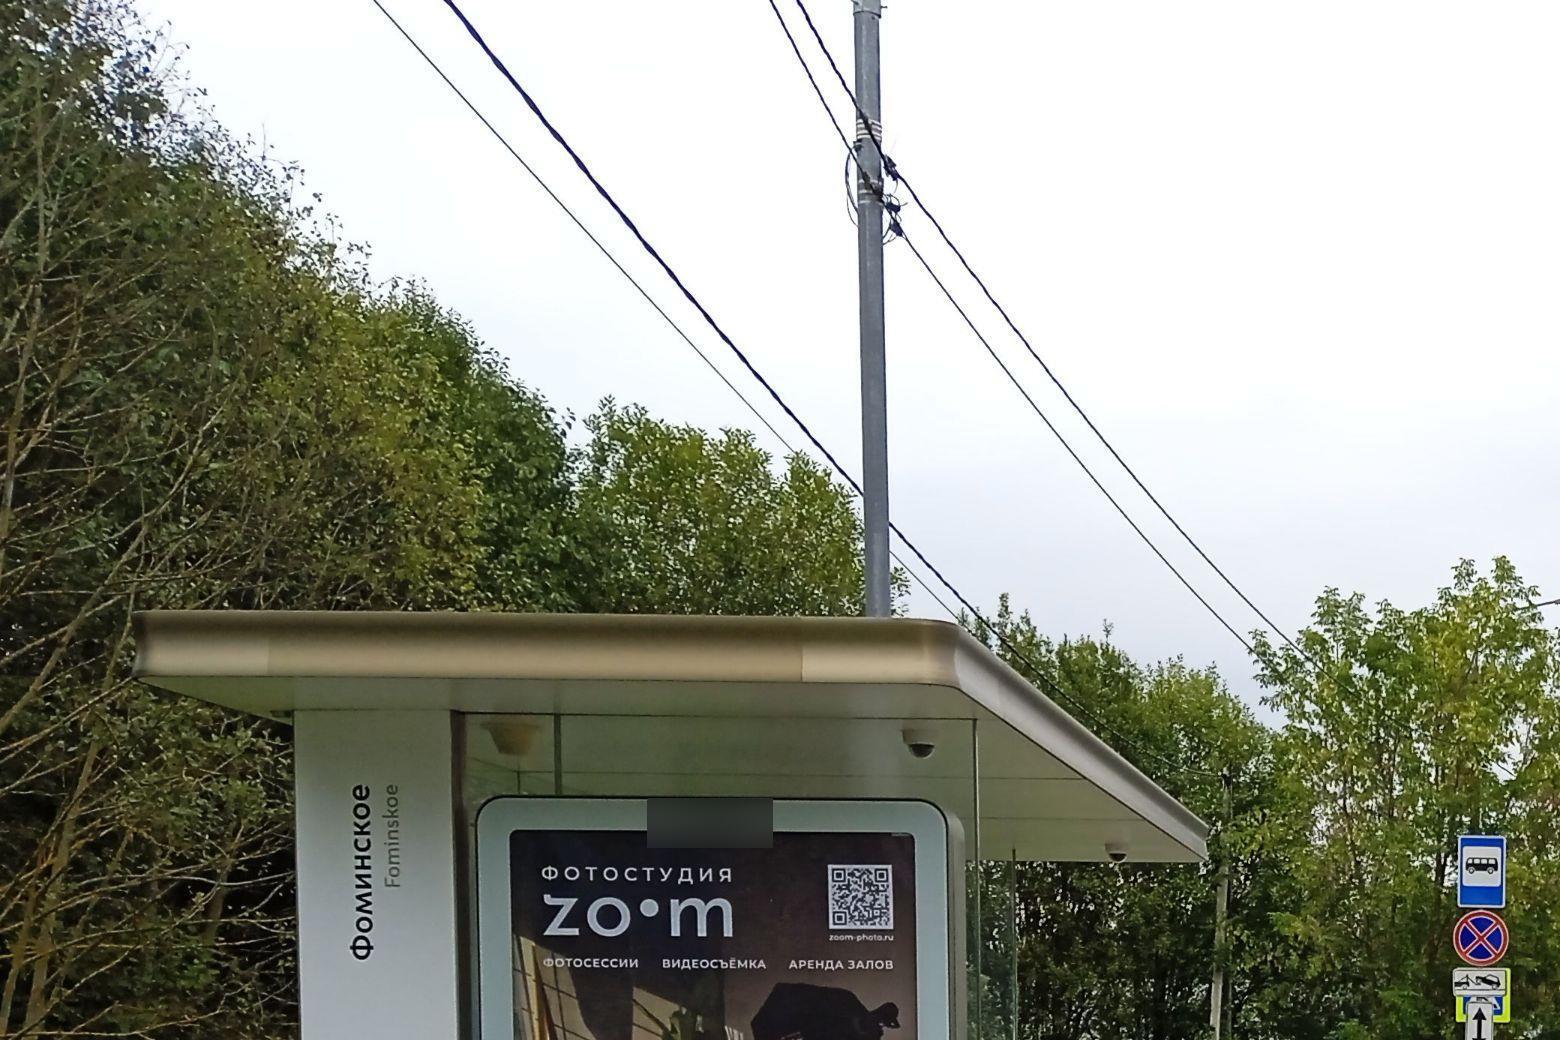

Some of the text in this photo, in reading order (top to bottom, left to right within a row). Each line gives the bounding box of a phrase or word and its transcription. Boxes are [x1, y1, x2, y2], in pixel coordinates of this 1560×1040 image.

[382, 784, 401, 888] Fominskoe
[350, 784, 374, 960] Фоминское
[541, 865, 732, 885] ФОТОСТУДИЯ
[828, 933, 894, 942] zoom-photo.ru
[543, 958, 639, 968] ФОТОСЕССИИ
[662, 957, 767, 970] ВИДЕОСЪЁМКА
[788, 959, 894, 971] АРЕНДА ЗАЛОВ
